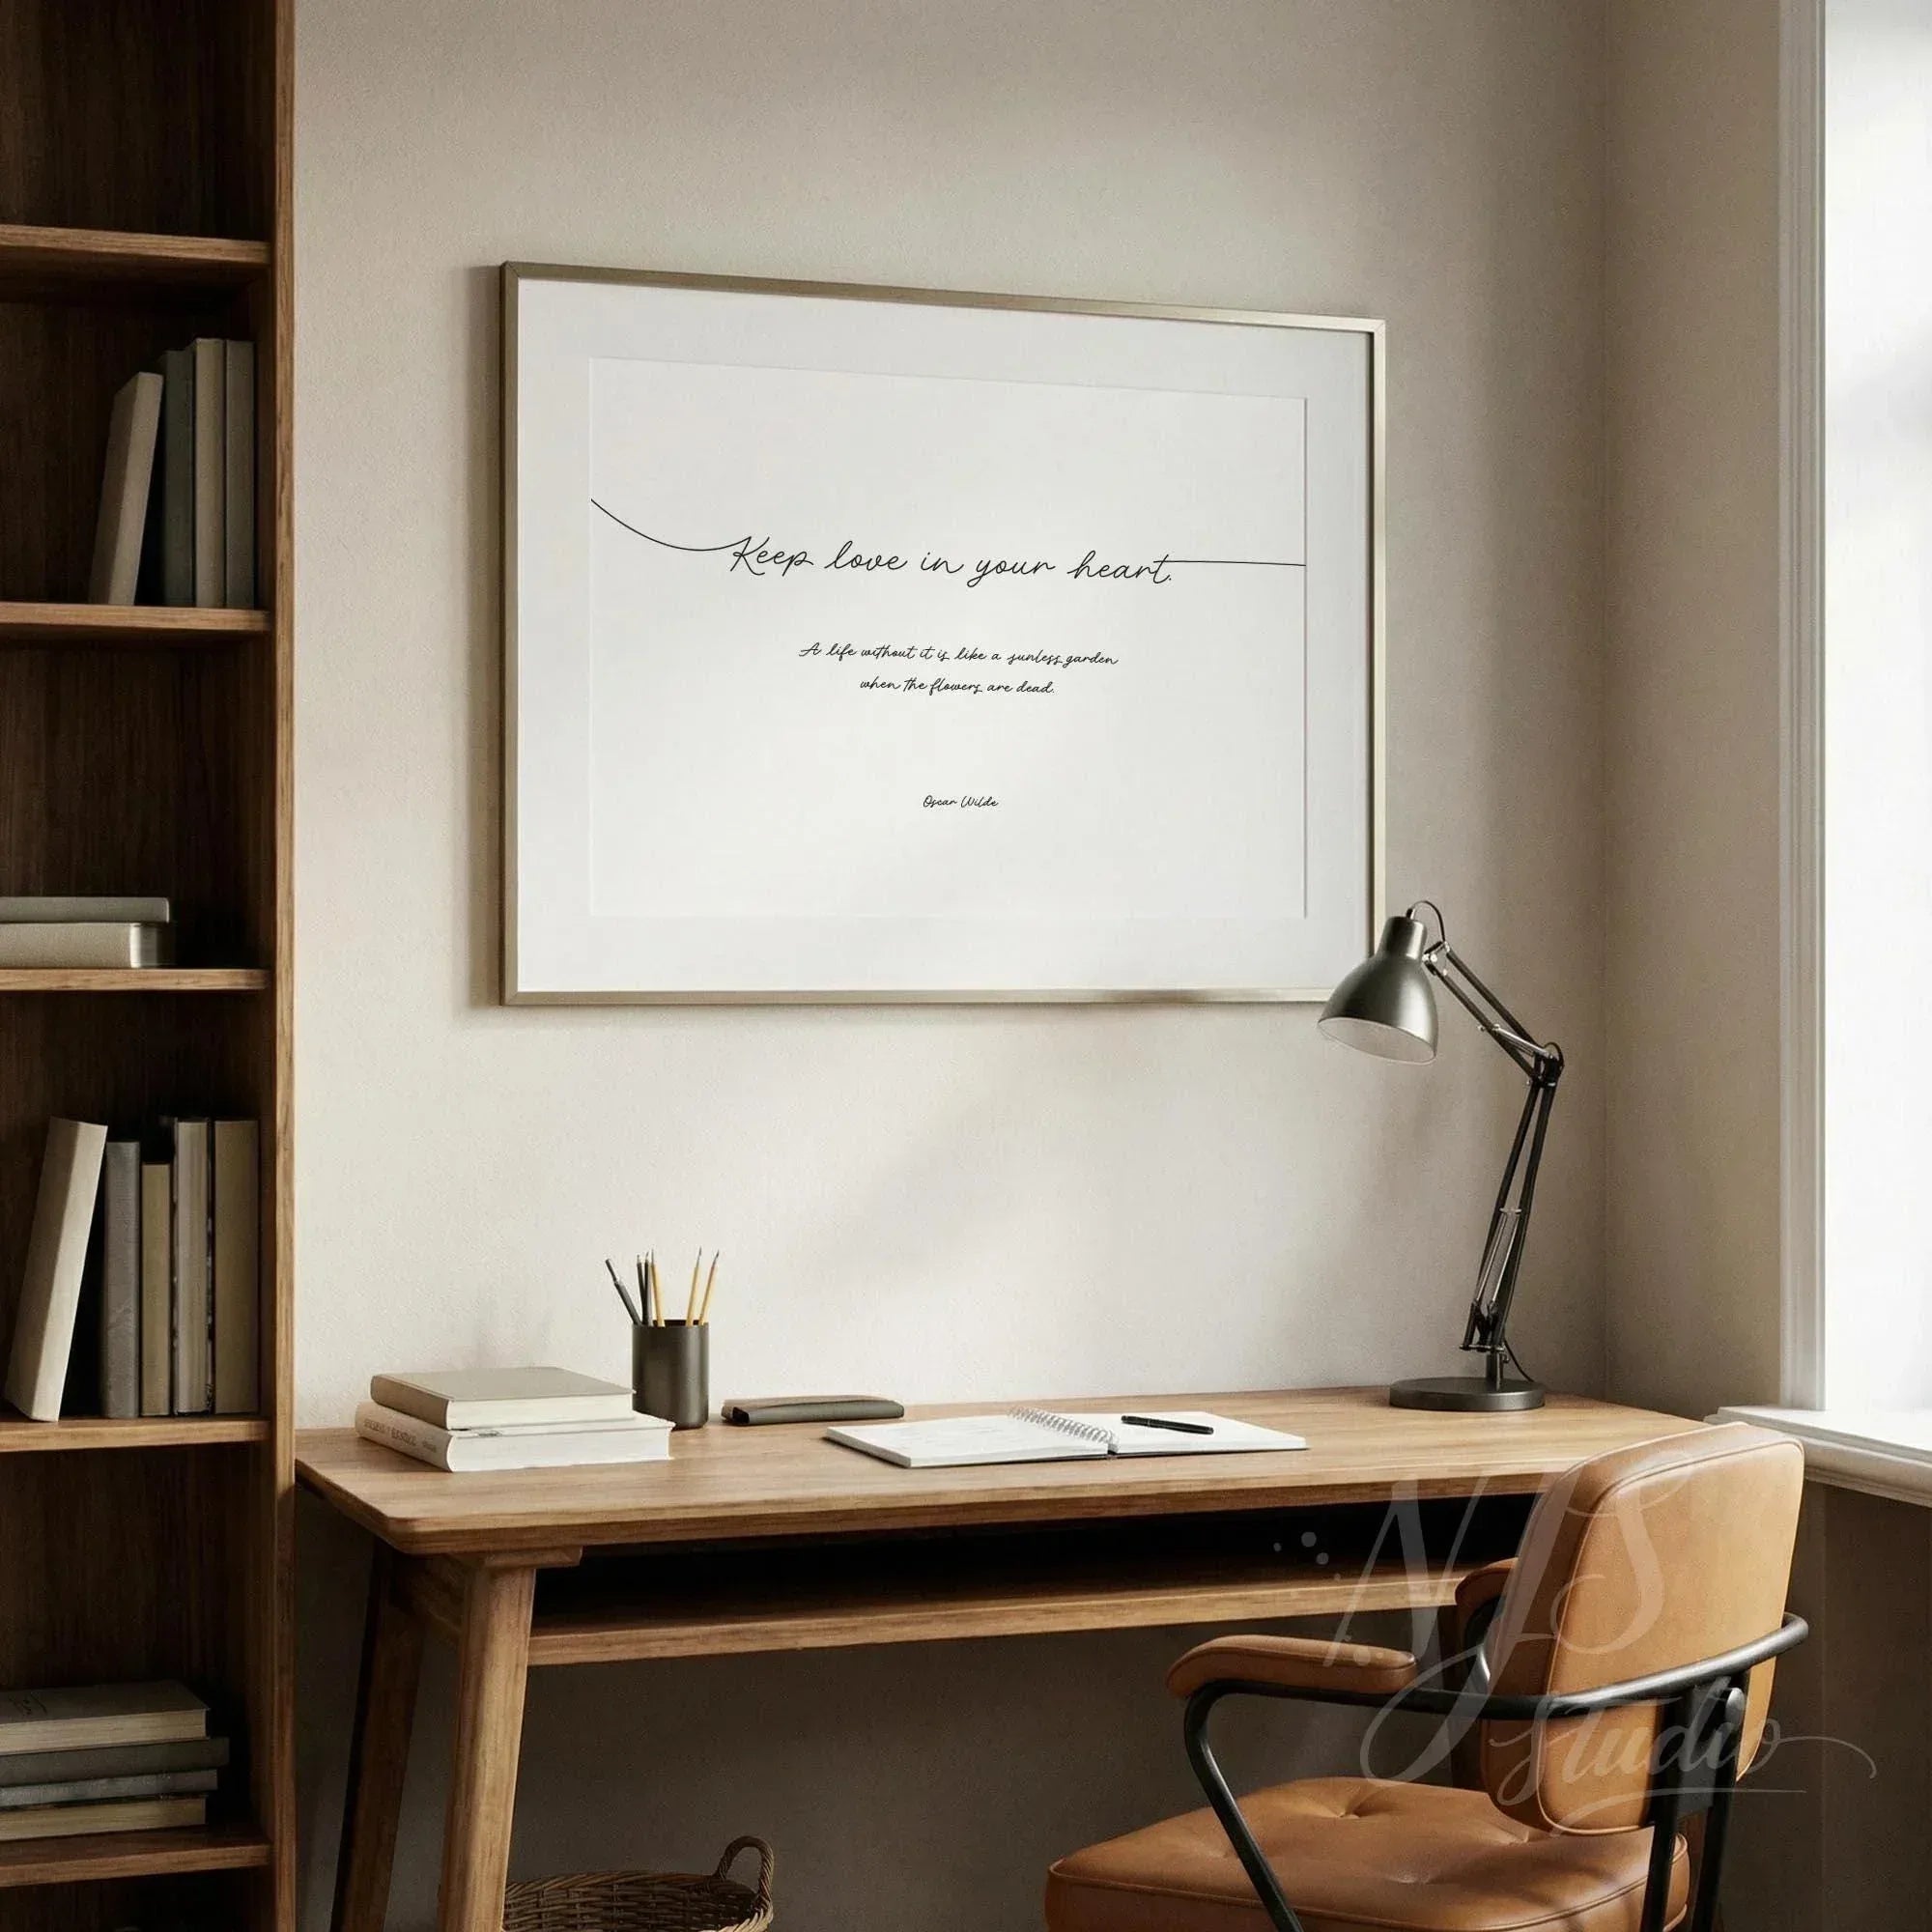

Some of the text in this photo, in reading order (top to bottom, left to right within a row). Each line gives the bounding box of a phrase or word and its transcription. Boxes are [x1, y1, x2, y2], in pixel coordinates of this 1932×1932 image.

[726, 535, 1175, 588] Keep love in your heart.
[798, 641, 823, 658] A
[825, 642, 858, 663] life
[860, 643, 919, 661] without
[919, 645, 936, 661] it
[936, 649, 951, 663] is
[952, 646, 988, 662] like
[1006, 648, 1064, 666] sunless
[1063, 651, 1120, 669] garden
[859, 675, 1056, 696] when the flowers are dead.
[923, 794, 1000, 809] Oscar Wilde
